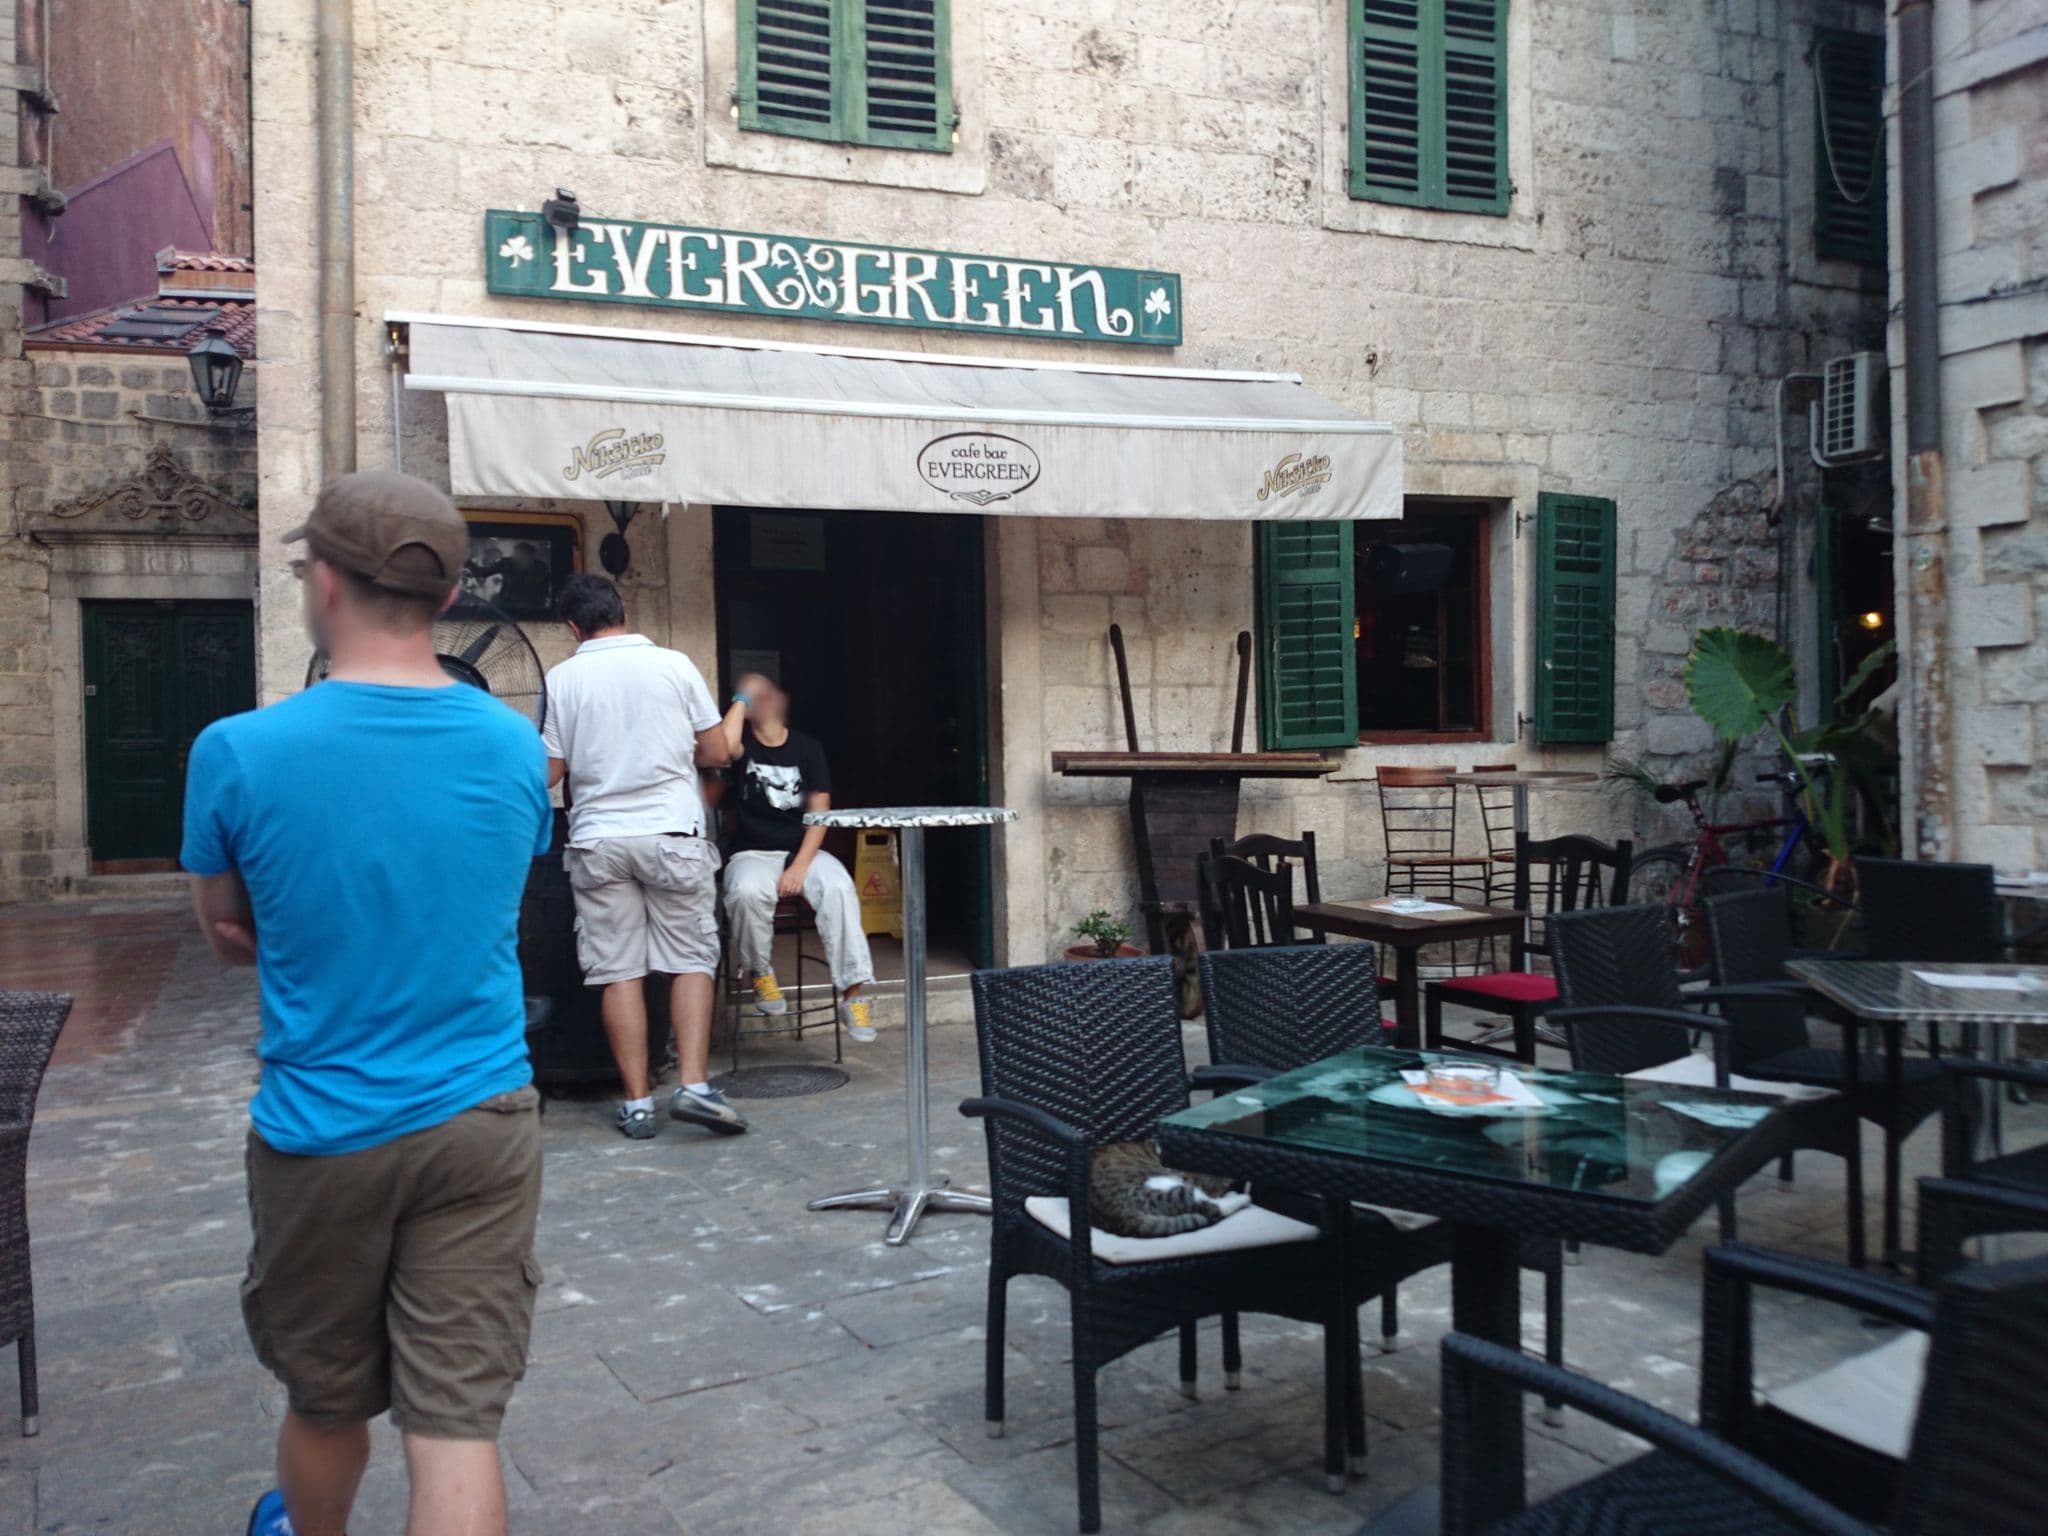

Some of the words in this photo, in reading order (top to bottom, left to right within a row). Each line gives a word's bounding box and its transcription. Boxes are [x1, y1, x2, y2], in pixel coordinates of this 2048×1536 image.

[951, 442, 980, 459] cafe
[983, 443, 1008, 460] bar
[928, 461, 1032, 480] EVERGREEN
